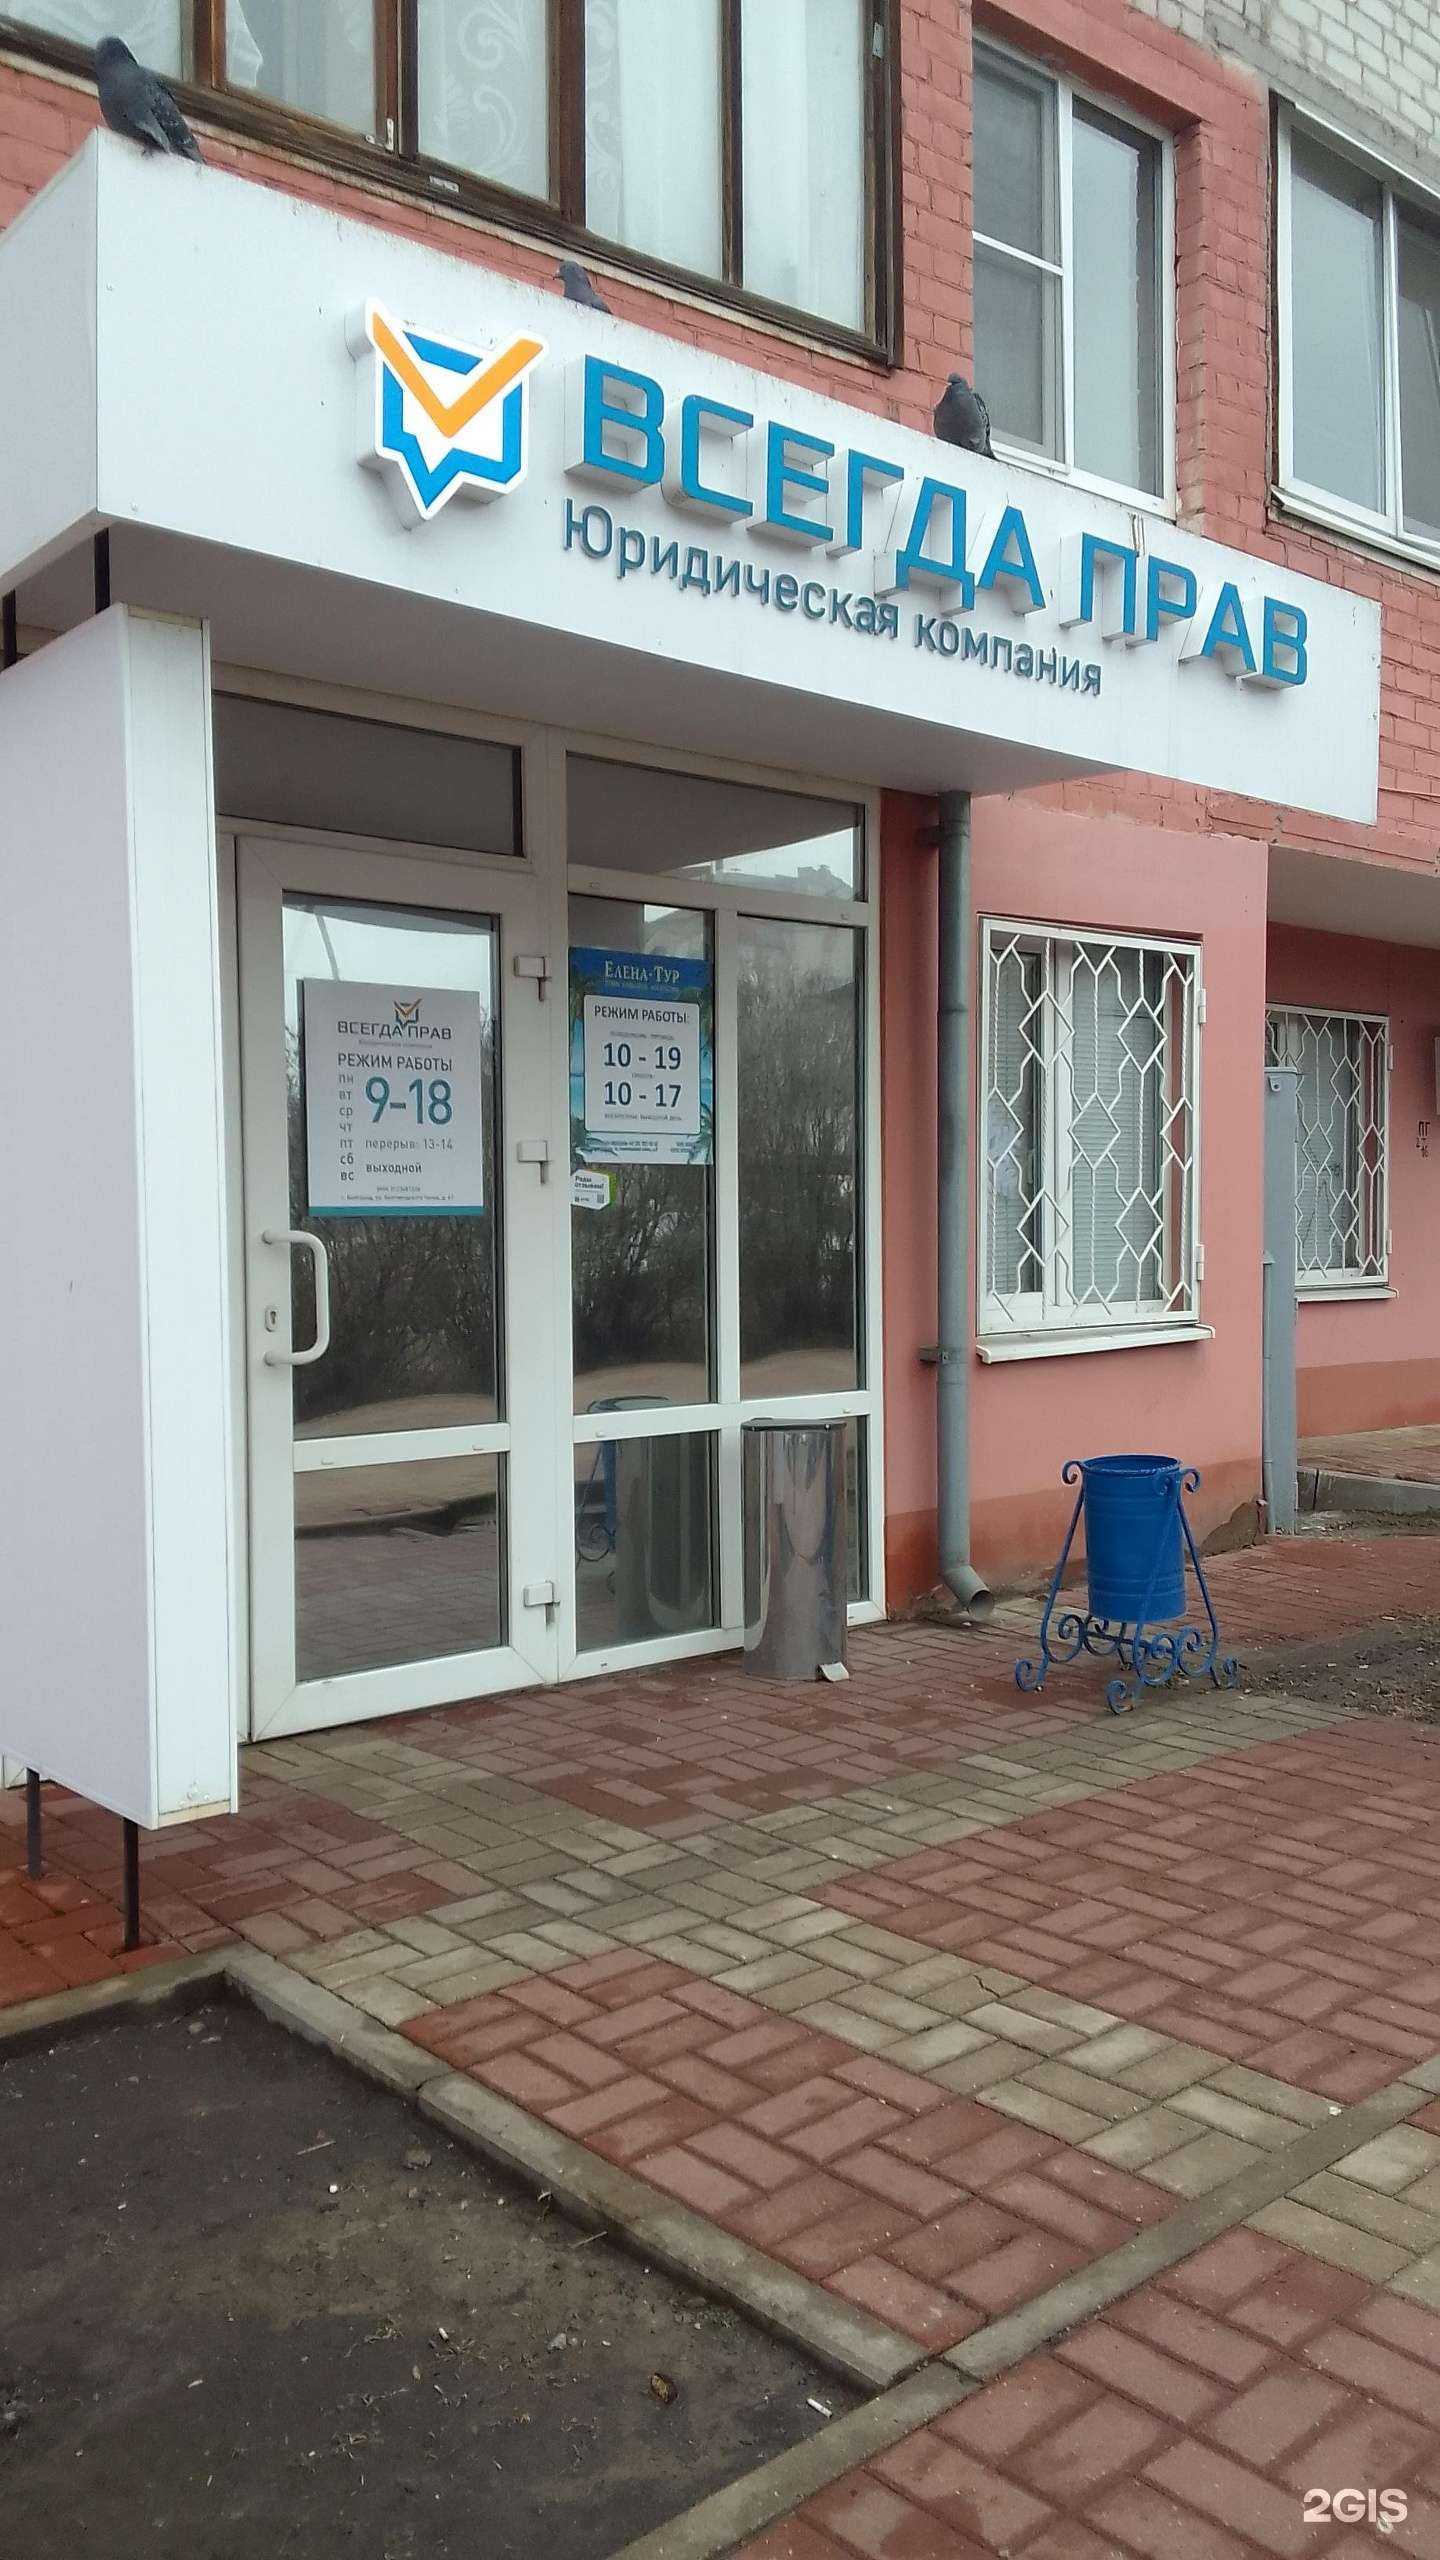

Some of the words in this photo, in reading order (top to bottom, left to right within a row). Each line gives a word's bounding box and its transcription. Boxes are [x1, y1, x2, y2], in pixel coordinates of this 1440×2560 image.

[581, 354, 1047, 612] ВСЕГДА
[1077, 531, 1309, 686] ПРАВ
[563, 498, 899, 638] Юридическая
[914, 613, 1101, 696] компания
[594, 1005, 639, 1020] РЕЖИМ
[338, 1021, 402, 1039] ВСЕГДА
[408, 1025, 452, 1039] ПРАВ
[338, 1053, 392, 1069] РЕЖИМ
[397, 1056, 452, 1072] РАБОТЫ
[604, 1043, 631, 1067] 10
[655, 1046, 681, 1070] 19
[365, 1076, 453, 1125] 9-18
[604, 1081, 631, 1105] 10
[656, 1083, 681, 1107] 17
[340, 1153, 354, 1165] сб
[366, 1162, 423, 1174] выходной
[340, 1171, 354, 1181] вс
